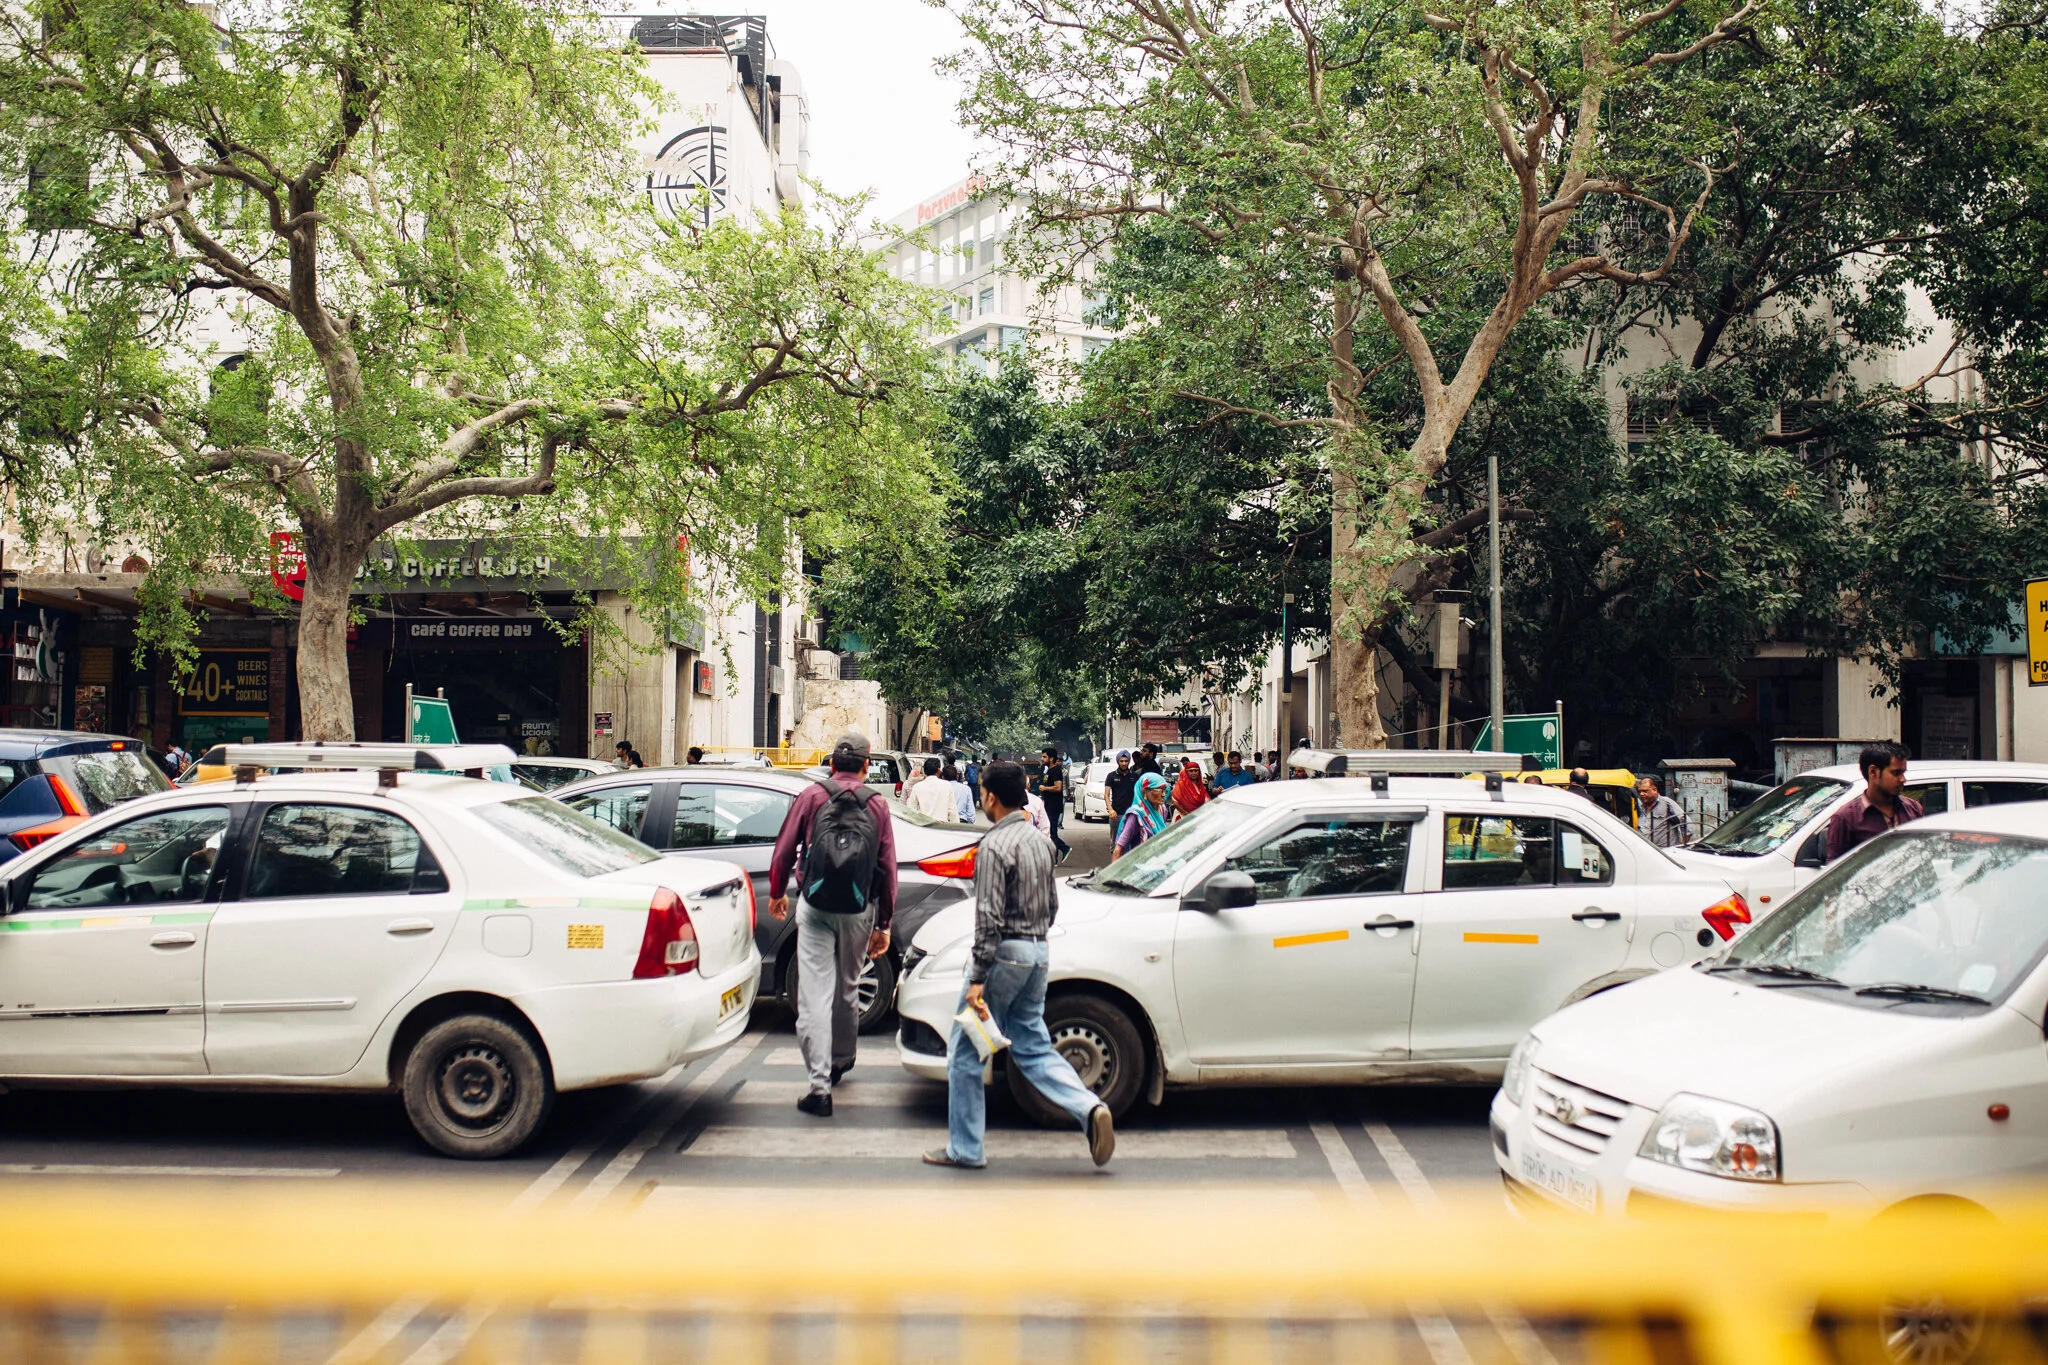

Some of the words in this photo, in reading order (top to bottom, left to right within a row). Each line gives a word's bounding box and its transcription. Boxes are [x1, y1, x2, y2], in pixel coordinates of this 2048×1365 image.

[238, 660, 268, 671] BEERS
[237, 675, 267, 685] WINES
[235, 689, 267, 701] COCKTAILS
[521, 722, 551, 730] FRUITY
